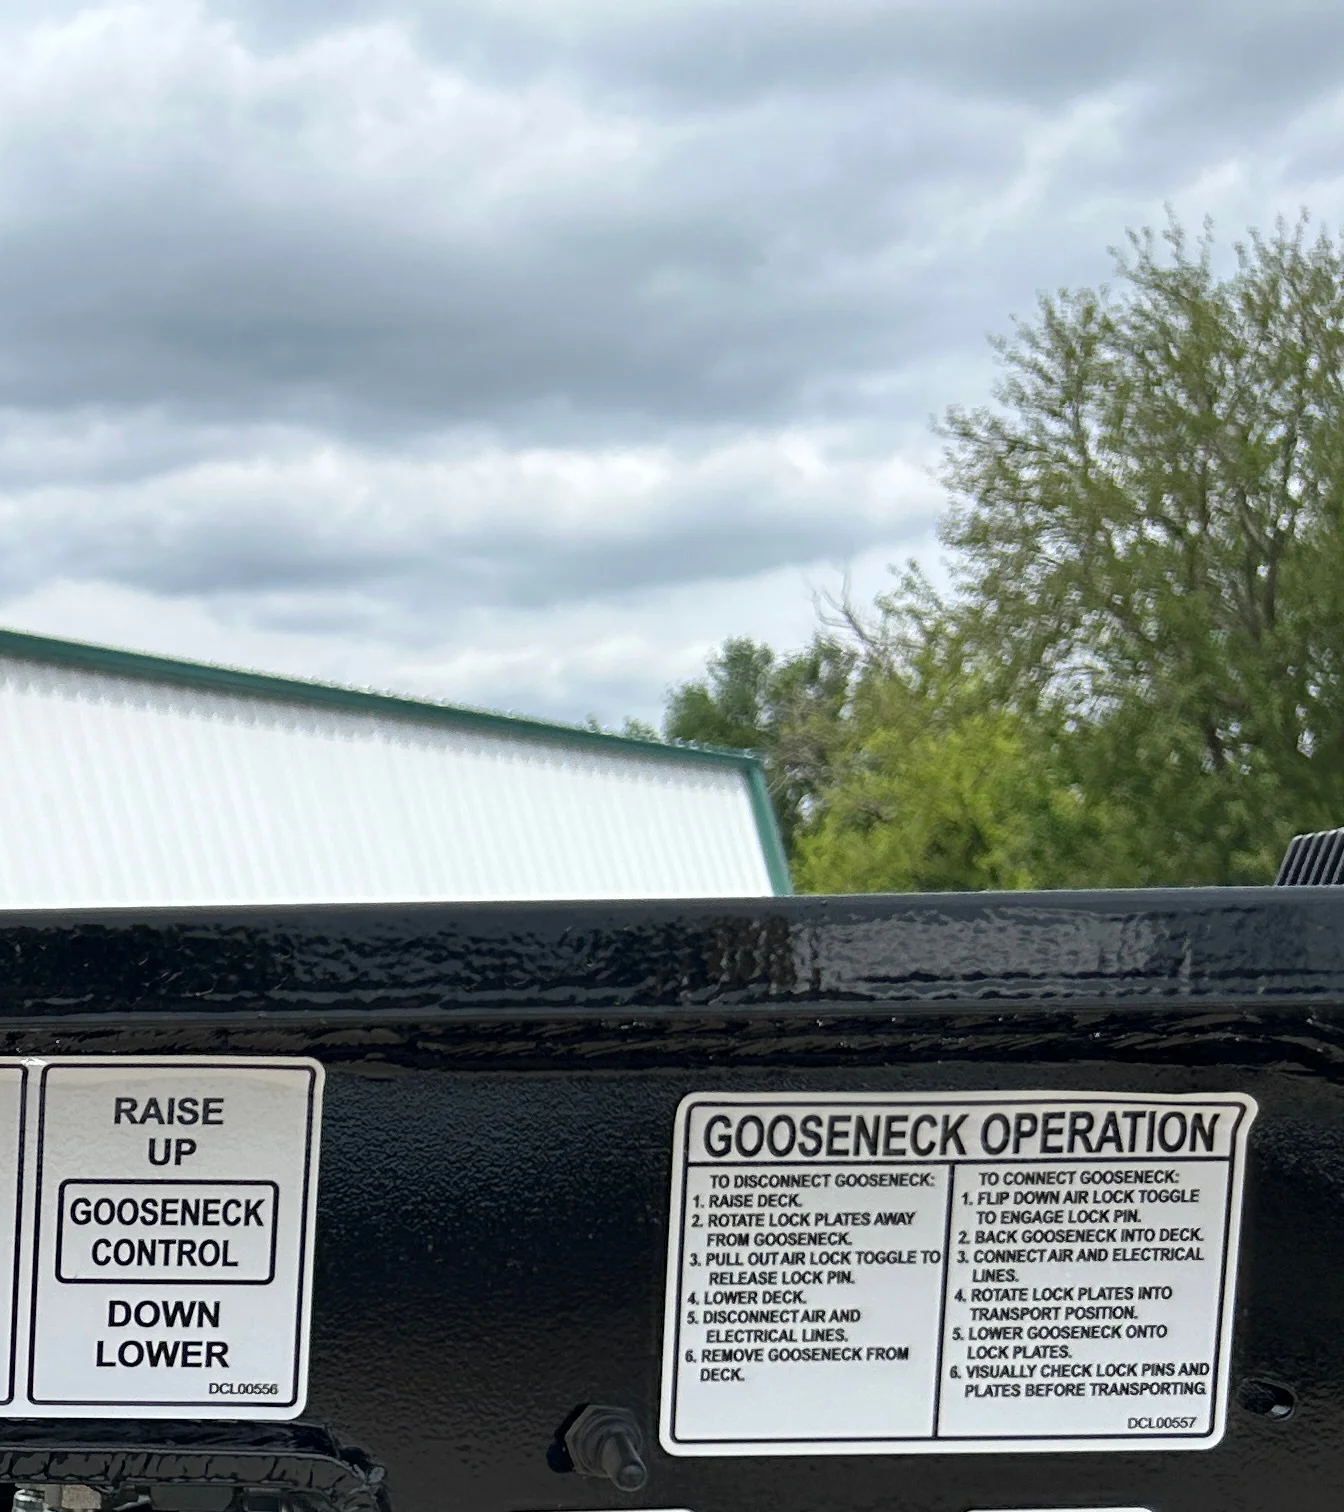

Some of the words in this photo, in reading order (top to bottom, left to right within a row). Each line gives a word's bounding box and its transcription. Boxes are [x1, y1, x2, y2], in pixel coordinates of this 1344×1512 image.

[115, 1097, 224, 1125] RAISE
[704, 1114, 969, 1157] GOOSENECK
[981, 1111, 1220, 1155] OPERATION
[149, 1138, 196, 1165] UP
[710, 1175, 729, 1188] TO
[734, 1174, 831, 1188] DISCONNECT
[835, 1173, 934, 1187] GOOSENECK:
[979, 1172, 999, 1186] TO
[1003, 1171, 1076, 1185] CONNECT
[1080, 1170, 1179, 1184] GOOSENECK:
[709, 1194, 753, 1208] RAISE
[758, 1194, 802, 1207] DECK.
[978, 1191, 1009, 1205] FLIP
[1014, 1191, 1059, 1205] DOWN
[1063, 1191, 1088, 1204] AIR
[1093, 1190, 1135, 1204] LOCK
[1138, 1189, 1200, 1203] TOGGLE
[71, 1198, 264, 1226] GOOSENECK
[708, 1213, 765, 1227] ROTATE
[769, 1213, 810, 1227] LOCK
[815, 1212, 871, 1226] PLATES
[874, 1212, 915, 1225] AWAY
[977, 1211, 996, 1224] TO
[1001, 1210, 1064, 1224] ENGAGE
[1068, 1210, 1109, 1223] LOCK
[1113, 1209, 1141, 1223] PIN.
[707, 1233, 749, 1246] FROM
[754, 1232, 852, 1246] GOOSENECK.
[975, 1230, 1017, 1244] BACK
[1022, 1229, 1117, 1243] GOOSENECK
[1121, 1229, 1155, 1242] INTO
[1159, 1228, 1204, 1241] DECK.
[92, 1239, 238, 1266] CONTROL
[706, 1253, 743, 1266] PULL
[748, 1252, 782, 1266] OUT
[780, 1252, 805, 1265] AIR
[810, 1251, 851, 1265] LOCK
[856, 1251, 916, 1264] TOGGLE
[921, 1250, 941, 1263] TO
[974, 1249, 1051, 1263] CONNECT
[1047, 1249, 1073, 1262] AIR
[1076, 1249, 1108, 1261] AND
[1113, 1247, 1204, 1261] ELECTRICAL
[709, 1272, 777, 1285] RELEASE
[782, 1271, 823, 1285] LOCK
[827, 1271, 855, 1284] PIN.
[973, 1269, 1019, 1282] LINES.
[705, 1291, 757, 1304] LOWER
[762, 1291, 806, 1304] DECK.
[972, 1288, 1028, 1302] ROTATE
[1033, 1287, 1074, 1301] LOCK
[1078, 1287, 1133, 1300] PLATES
[1138, 1286, 1172, 1299] INTO
[108, 1301, 220, 1327] DOWN
[703, 1310, 799, 1323] DISCONNECT
[801, 1310, 825, 1322] AIR
[829, 1309, 860, 1322] AND
[970, 1307, 1061, 1321] TRANSPORT
[1065, 1306, 1138, 1320] POSITION.
[707, 1329, 797, 1343] ELECTRICAL
[802, 1328, 848, 1342] LINES.
[969, 1327, 1023, 1340] LOWER
[1027, 1325, 1122, 1339] GOOSENECK
[1126, 1325, 1167, 1338] ONTO
[96, 1341, 229, 1368] LOWER
[702, 1349, 763, 1362] REMOVE
[768, 1348, 862, 1361] GOOSENECK
[867, 1347, 909, 1360] FROM
[967, 1346, 1008, 1359] LOCK
[1013, 1345, 1072, 1359] PLATES.
[700, 1368, 744, 1381] DECK.
[966, 1365, 1037, 1378] VISUALLY
[1040, 1364, 1092, 1378] CHECK
[1096, 1363, 1137, 1377] LOCK
[1142, 1363, 1175, 1376] PINS
[1178, 1363, 1209, 1376] AND
[965, 1384, 1020, 1397] PLATES
[1026, 1383, 1085, 1397] BEFORE
[1128, 1417, 1197, 1429] DCL00557
